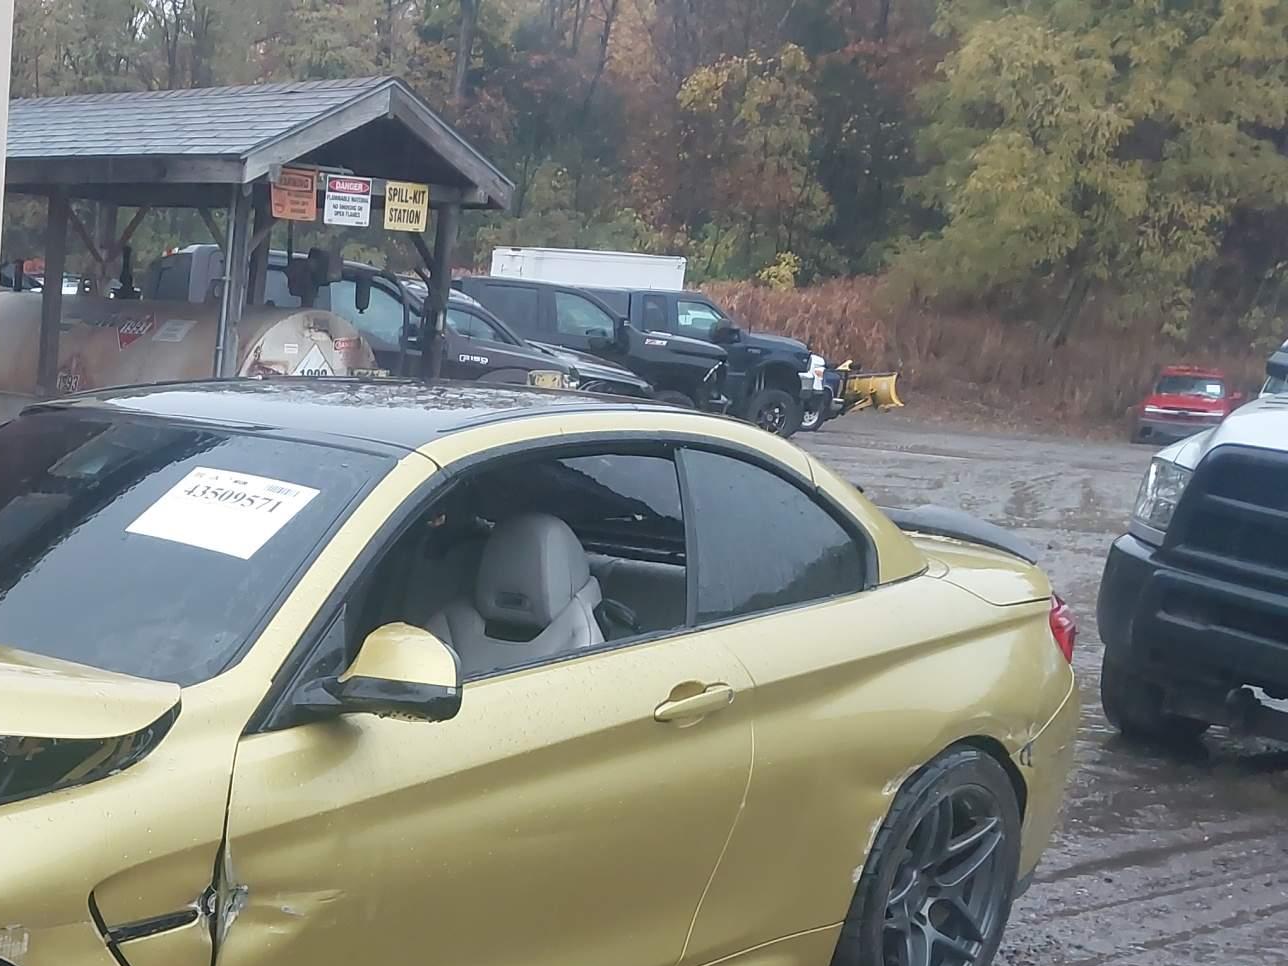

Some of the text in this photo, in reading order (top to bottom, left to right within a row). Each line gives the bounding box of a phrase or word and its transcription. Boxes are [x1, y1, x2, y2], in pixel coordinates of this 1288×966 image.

[335, 180, 363, 192] DANGER
[388, 187, 426, 205] SPILL-KIT
[389, 207, 421, 225] STATION
[184, 484, 283, 513] 43509571
